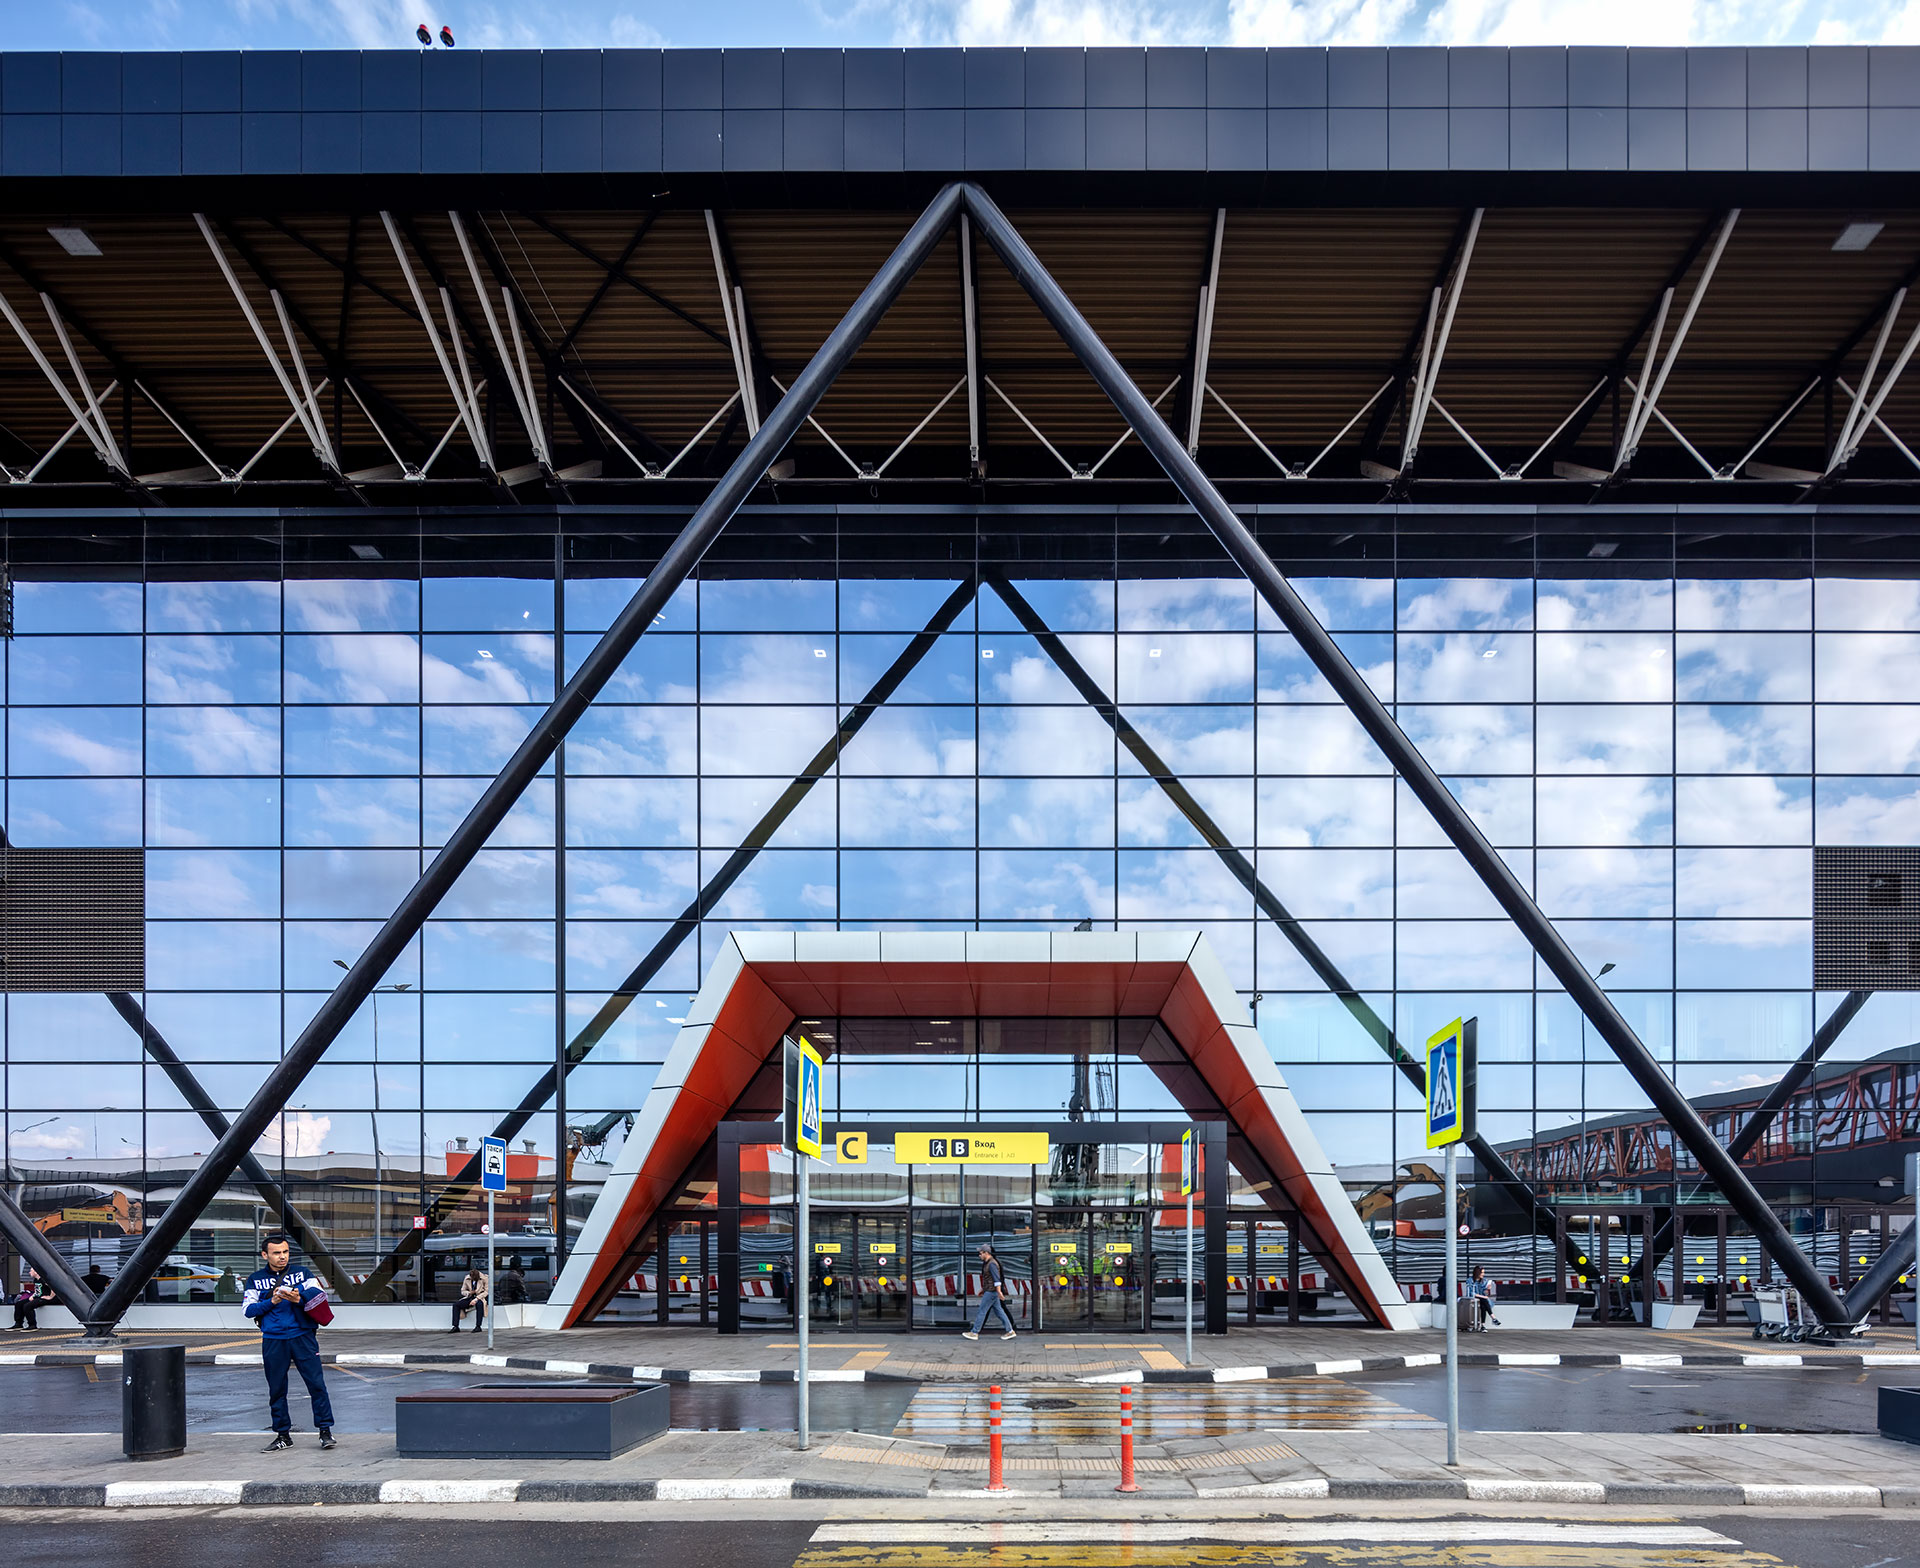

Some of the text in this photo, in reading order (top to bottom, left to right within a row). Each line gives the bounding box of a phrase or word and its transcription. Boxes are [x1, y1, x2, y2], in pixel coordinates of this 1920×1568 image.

[842, 1136, 859, 1160] C
[955, 1141, 966, 1155] B
[974, 1140, 996, 1149] Вход
